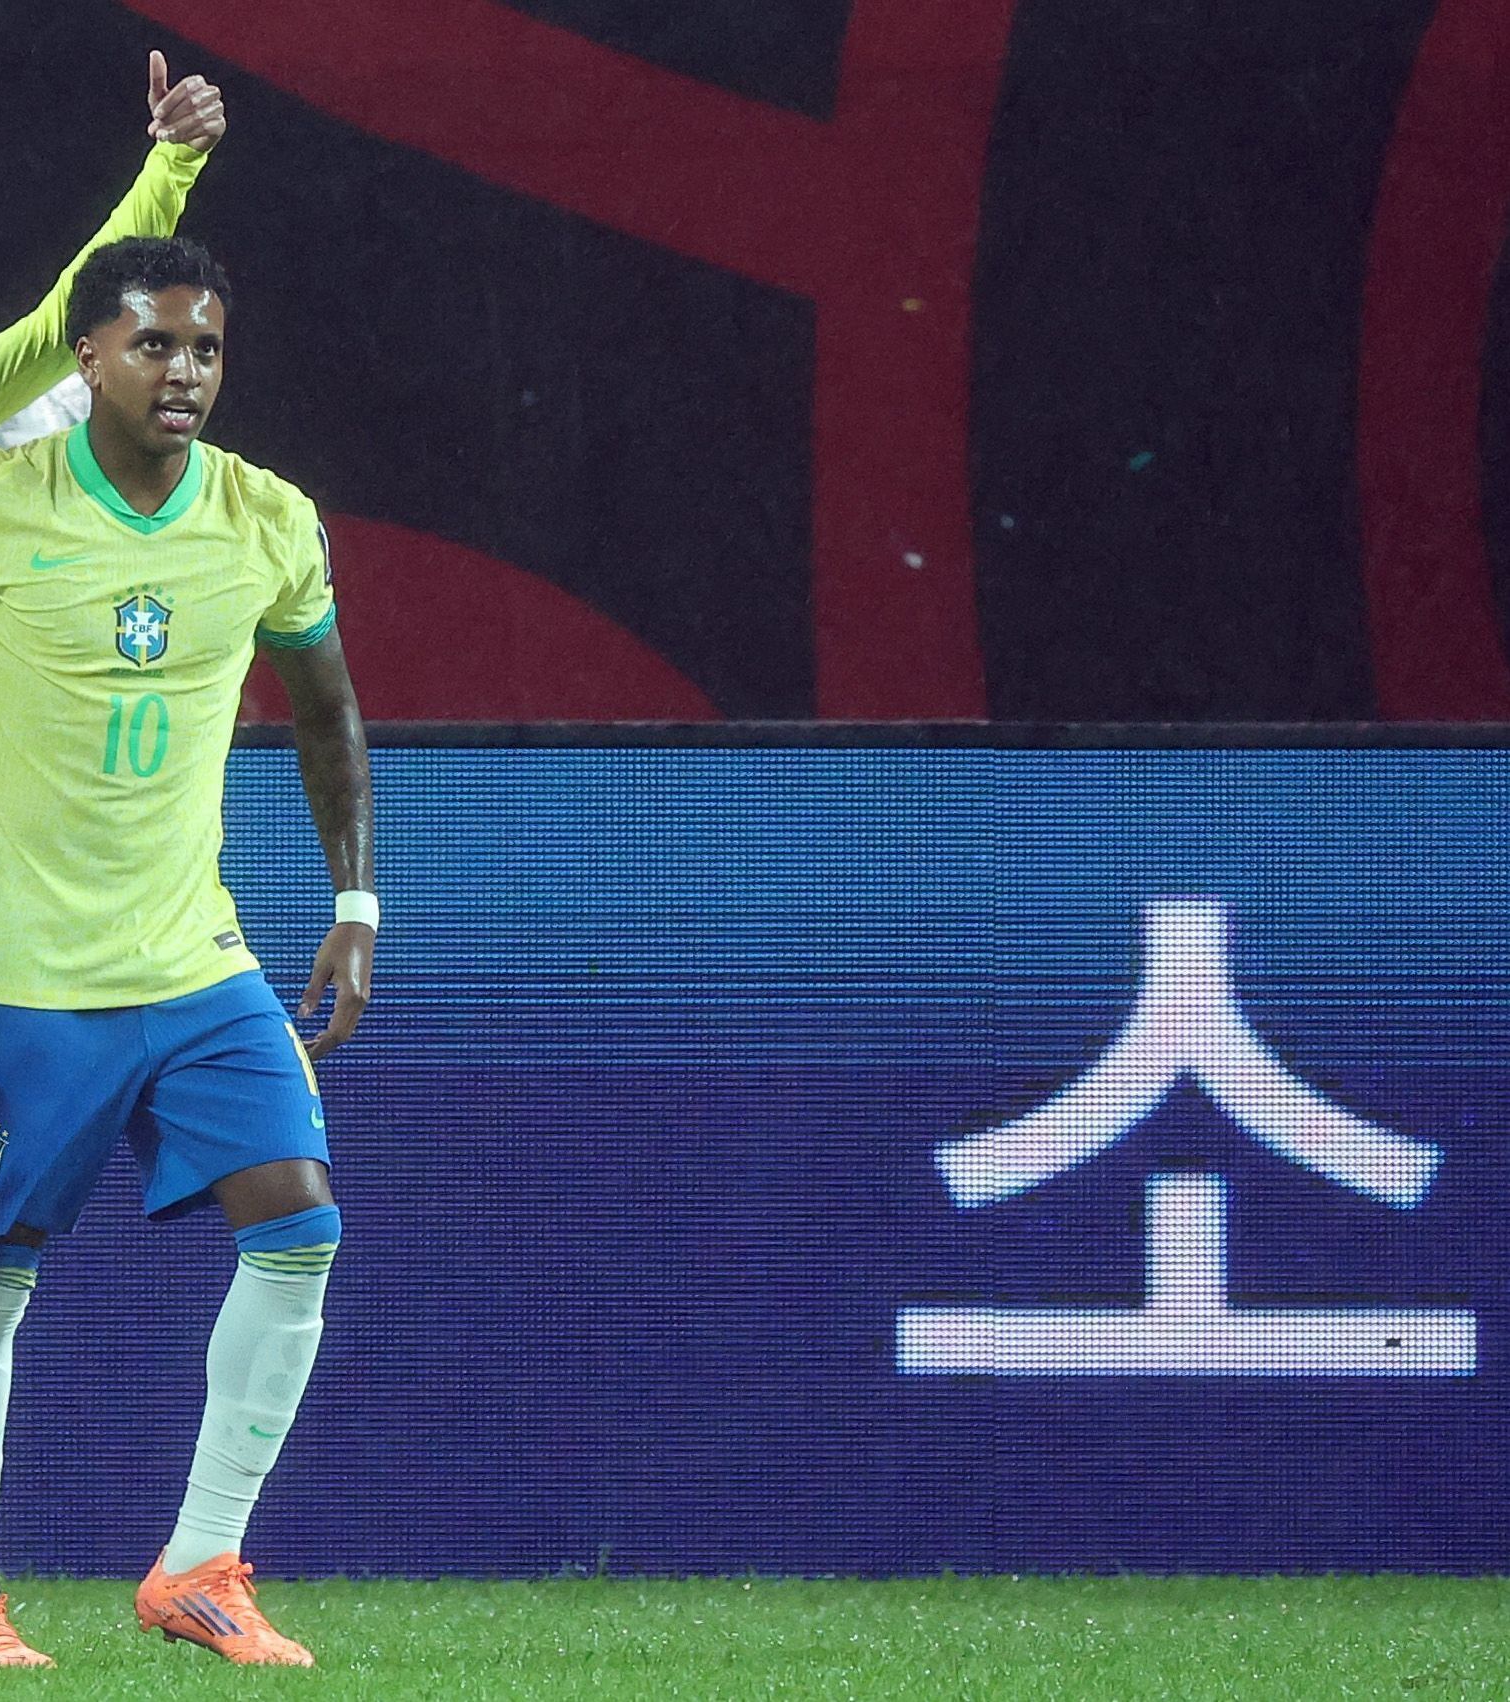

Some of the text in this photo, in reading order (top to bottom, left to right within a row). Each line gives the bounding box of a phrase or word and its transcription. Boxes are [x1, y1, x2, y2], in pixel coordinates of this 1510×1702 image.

[131, 623, 153, 633] CBF
[102, 692, 170, 779] 10
[895, 894, 1478, 1377] 소
